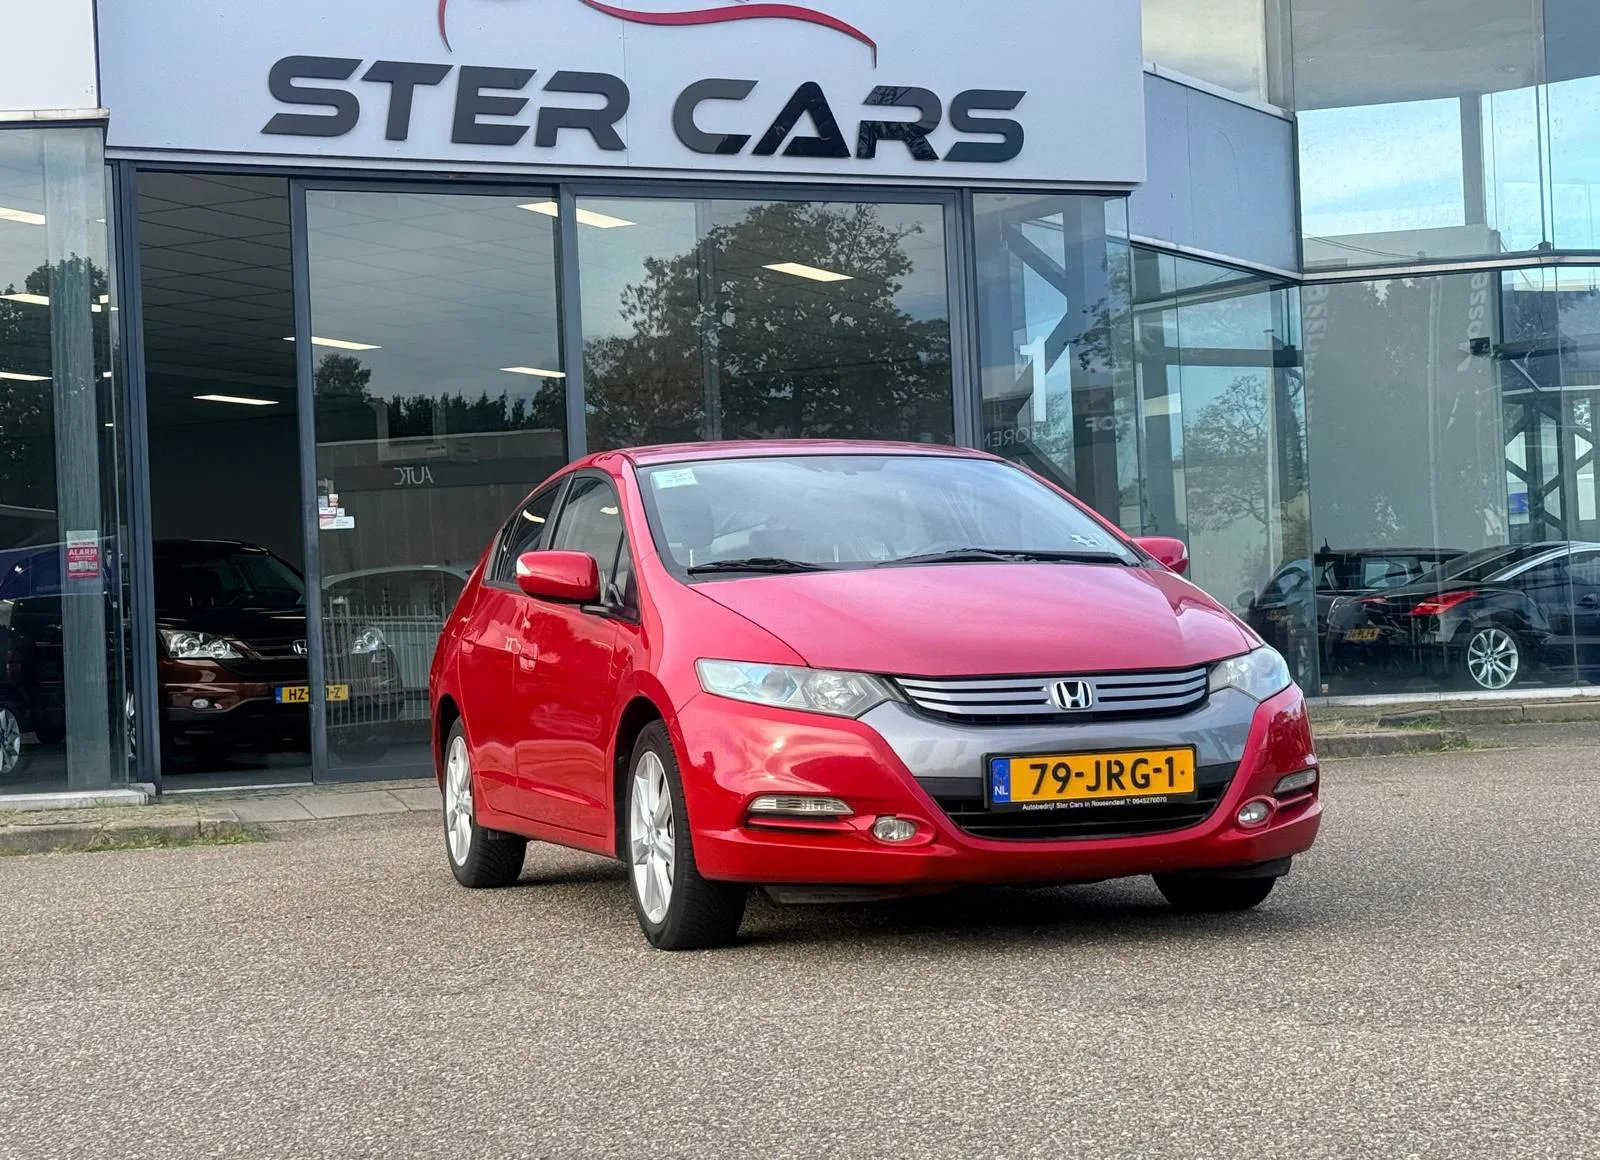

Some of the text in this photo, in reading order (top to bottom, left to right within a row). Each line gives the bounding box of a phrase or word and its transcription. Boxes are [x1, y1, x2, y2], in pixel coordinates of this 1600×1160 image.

[260, 55, 1027, 162] STER CARS
[69, 548, 98, 556] ALARM
[994, 756, 1175, 796] NL 79-JRG-1
[1069, 801, 1084, 809] Cars
